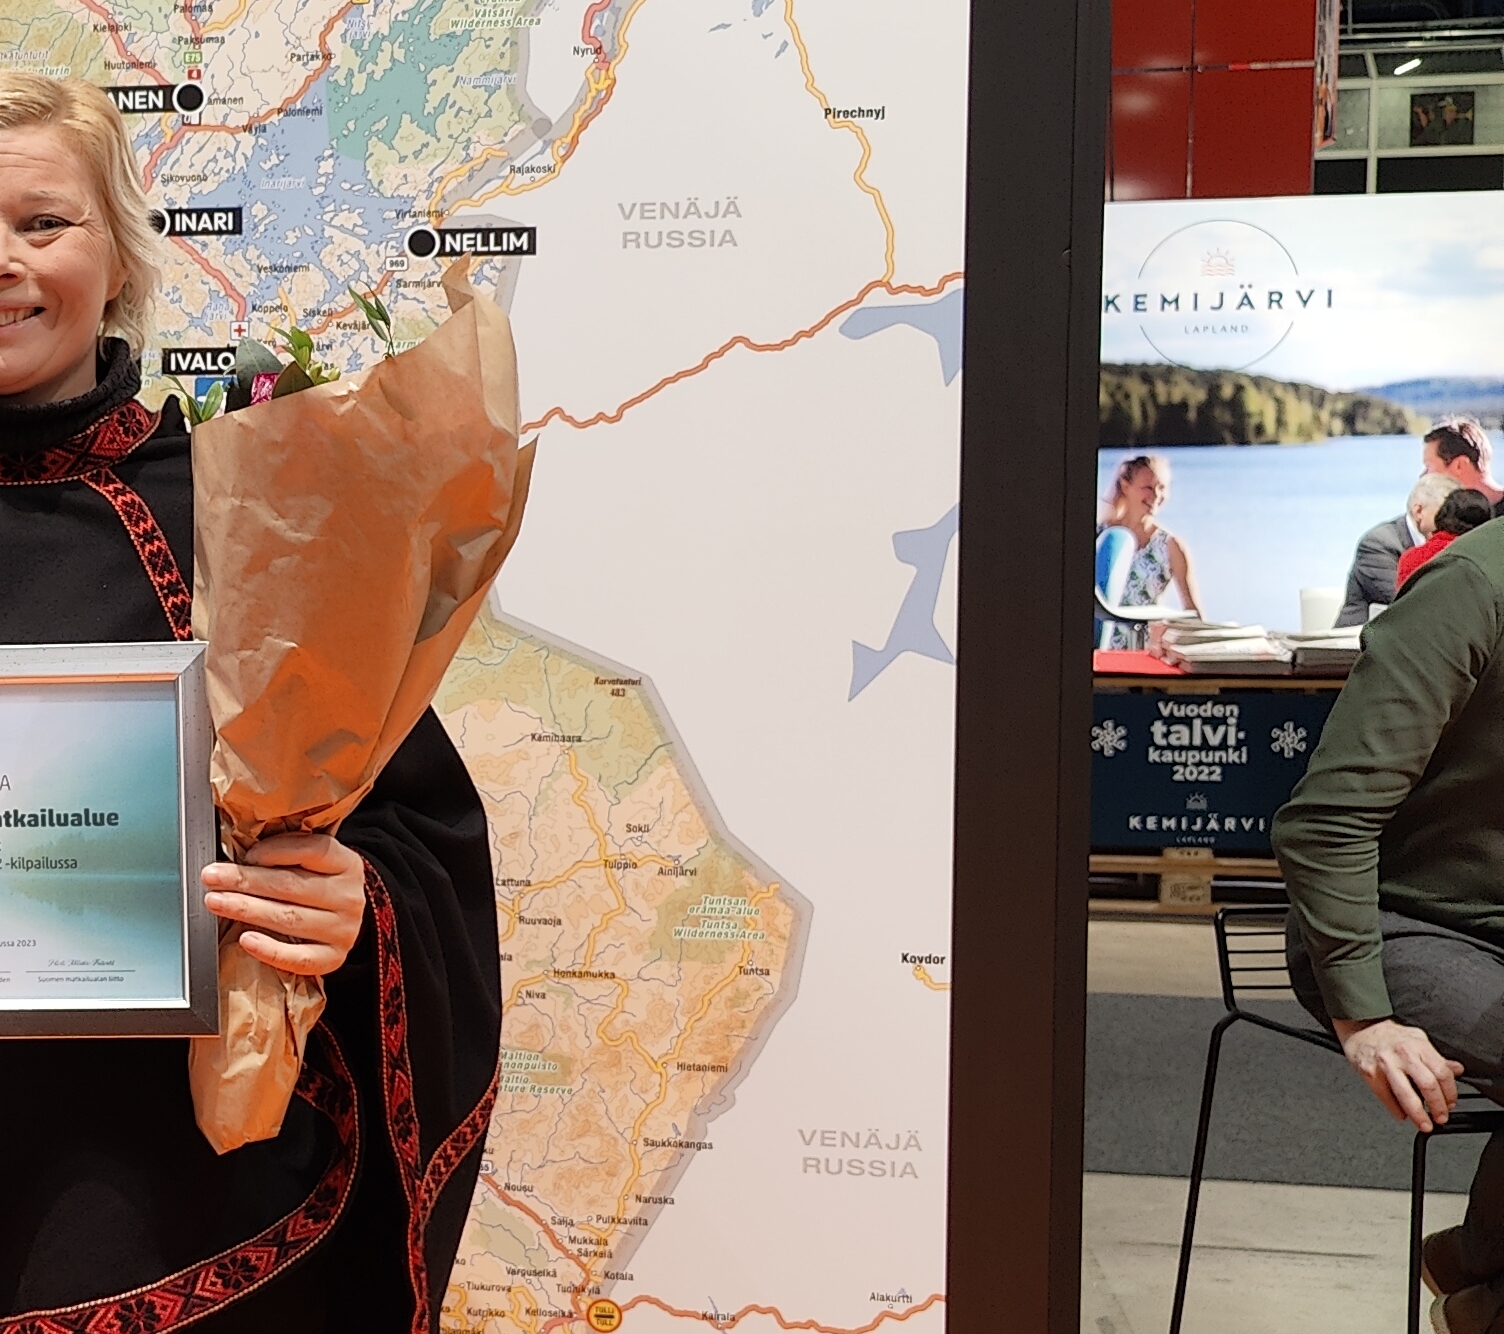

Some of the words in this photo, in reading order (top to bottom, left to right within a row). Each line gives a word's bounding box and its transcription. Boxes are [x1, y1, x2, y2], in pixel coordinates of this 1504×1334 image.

[573, 45, 602, 57] Nyrud
[824, 106, 886, 121] Pirechnyj
[509, 164, 556, 176] Rajakoski
[618, 197, 742, 220] VENÄJÄ
[175, 212, 233, 232] INARI
[445, 233, 528, 252] NELLIM
[622, 229, 738, 249] RUSSIA
[1104, 284, 1332, 313] KEMIJÄRVI
[1185, 325, 1249, 334] LAPLAND
[170, 351, 235, 371] IVALO
[1157, 701, 1239, 717] Vuoden
[1148, 746, 1247, 765] kaupunki
[1172, 765, 1222, 782] 2022
[625, 823, 650, 834] Sokli
[1128, 813, 1266, 832] KEMIJÄRVI
[5, 857, 78, 872] -kilpailussa
[604, 858, 638, 871] Tulppio
[16, 939, 36, 947] 2023
[901, 952, 946, 966] Kovdor
[553, 968, 616, 980] Honkamukka
[525, 989, 546, 1000] Niva
[676, 1062, 729, 1073] Hietaniemi
[642, 1138, 714, 1151] Saukkokangas
[797, 1128, 923, 1152] VENÄJÄ
[802, 1157, 920, 1179] RUSSIA
[635, 1194, 675, 1206] Naruska
[568, 1236, 609, 1247] Mukkala
[604, 1271, 634, 1282] Kotala
[869, 1292, 913, 1304] Alakurtti
